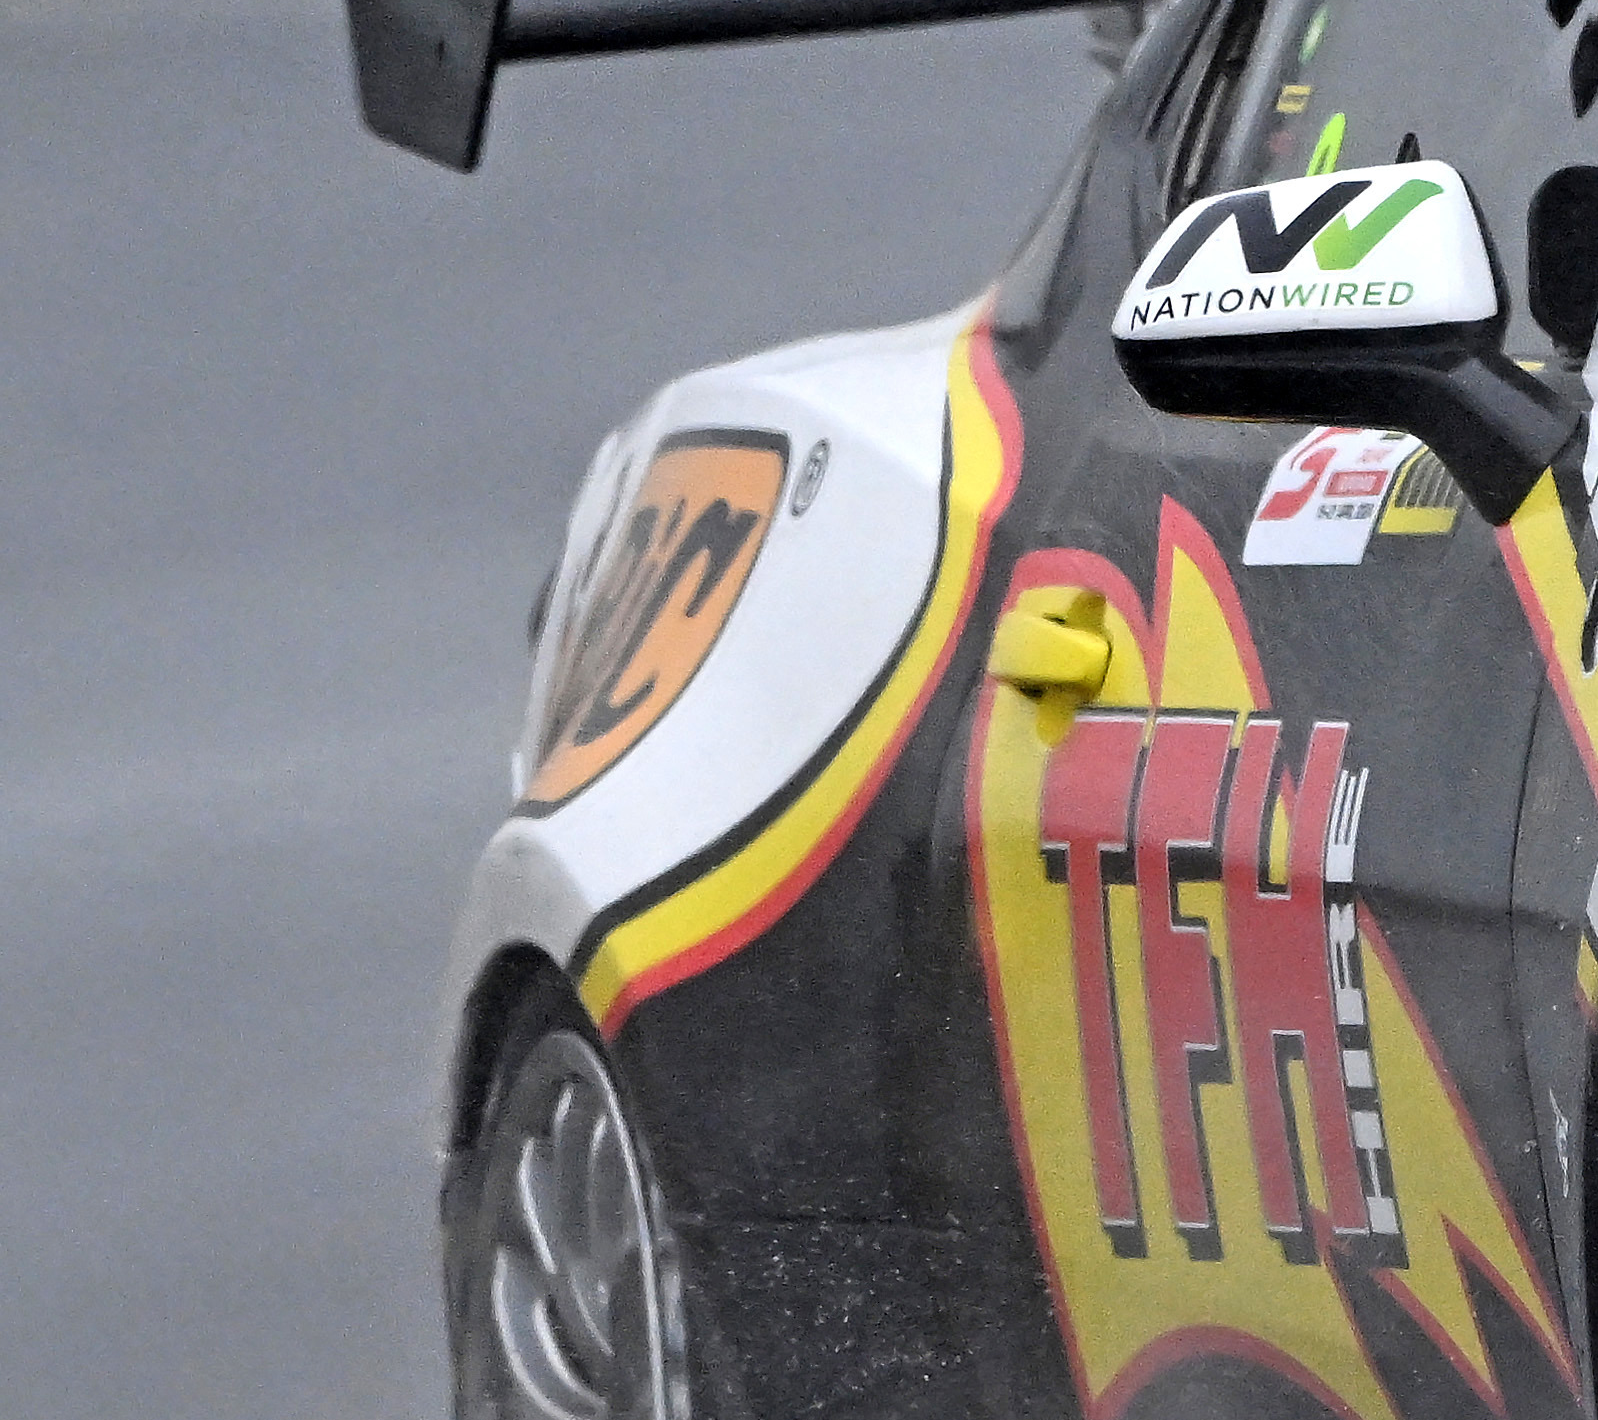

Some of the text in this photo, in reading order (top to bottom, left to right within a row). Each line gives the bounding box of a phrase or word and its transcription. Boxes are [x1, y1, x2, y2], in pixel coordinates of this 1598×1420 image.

[1130, 279, 1415, 329] NATIONWIRED
[1040, 713, 1372, 1235] TFH
[1325, 766, 1400, 1235] HIRE
